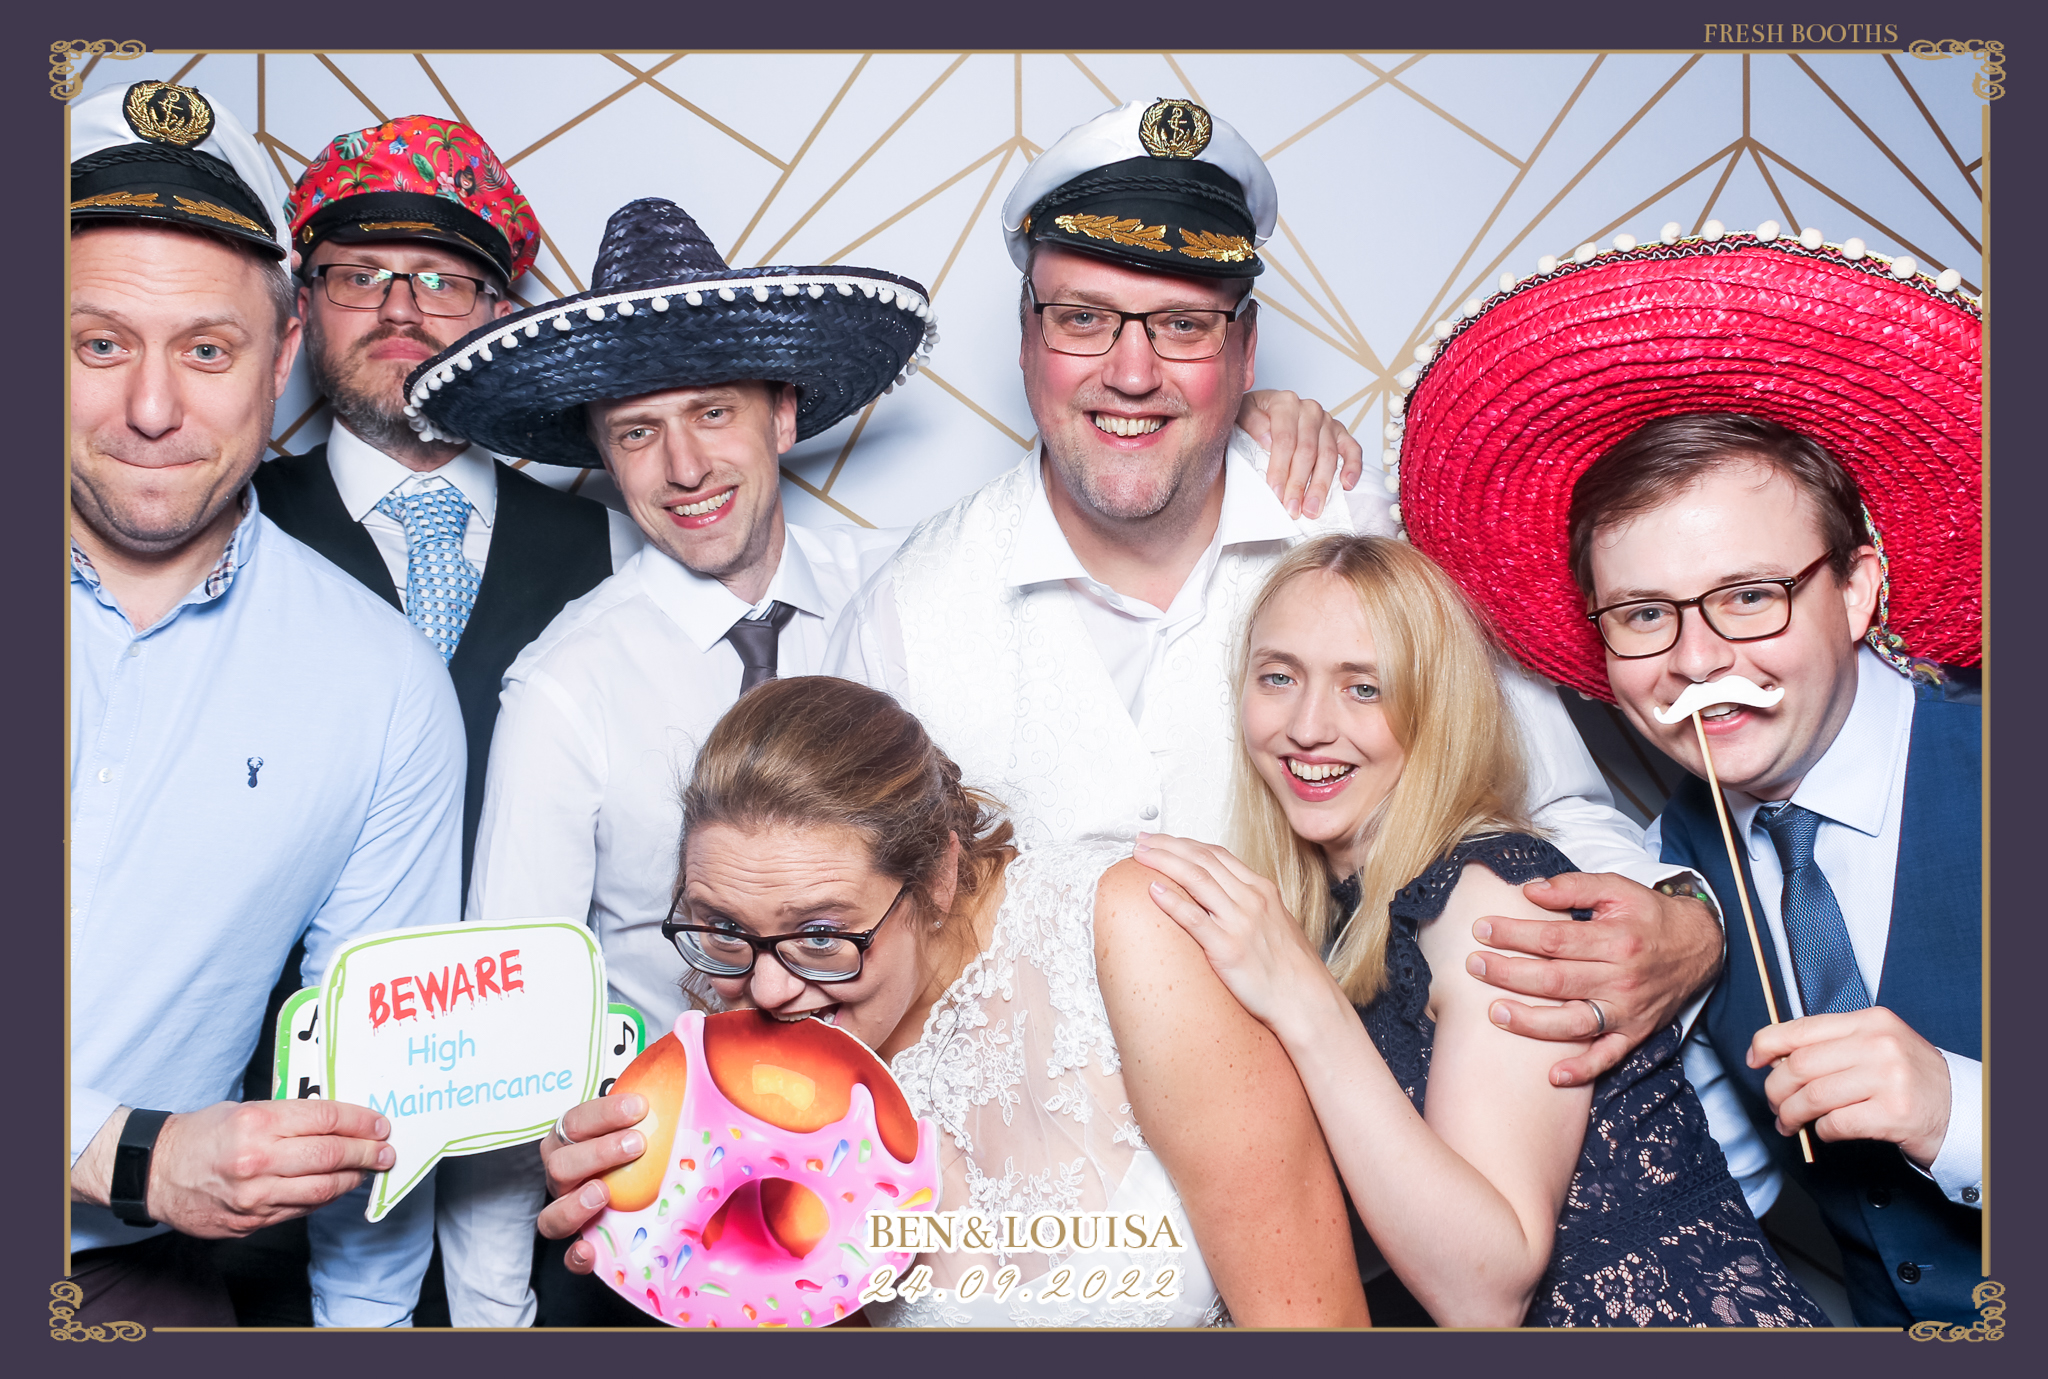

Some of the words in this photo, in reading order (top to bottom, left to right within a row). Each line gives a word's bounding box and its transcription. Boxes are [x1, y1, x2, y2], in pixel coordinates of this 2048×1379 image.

[369, 949, 524, 1033] BEWARE
[408, 1029, 475, 1071] High
[368, 1069, 573, 1118] Maintencance
